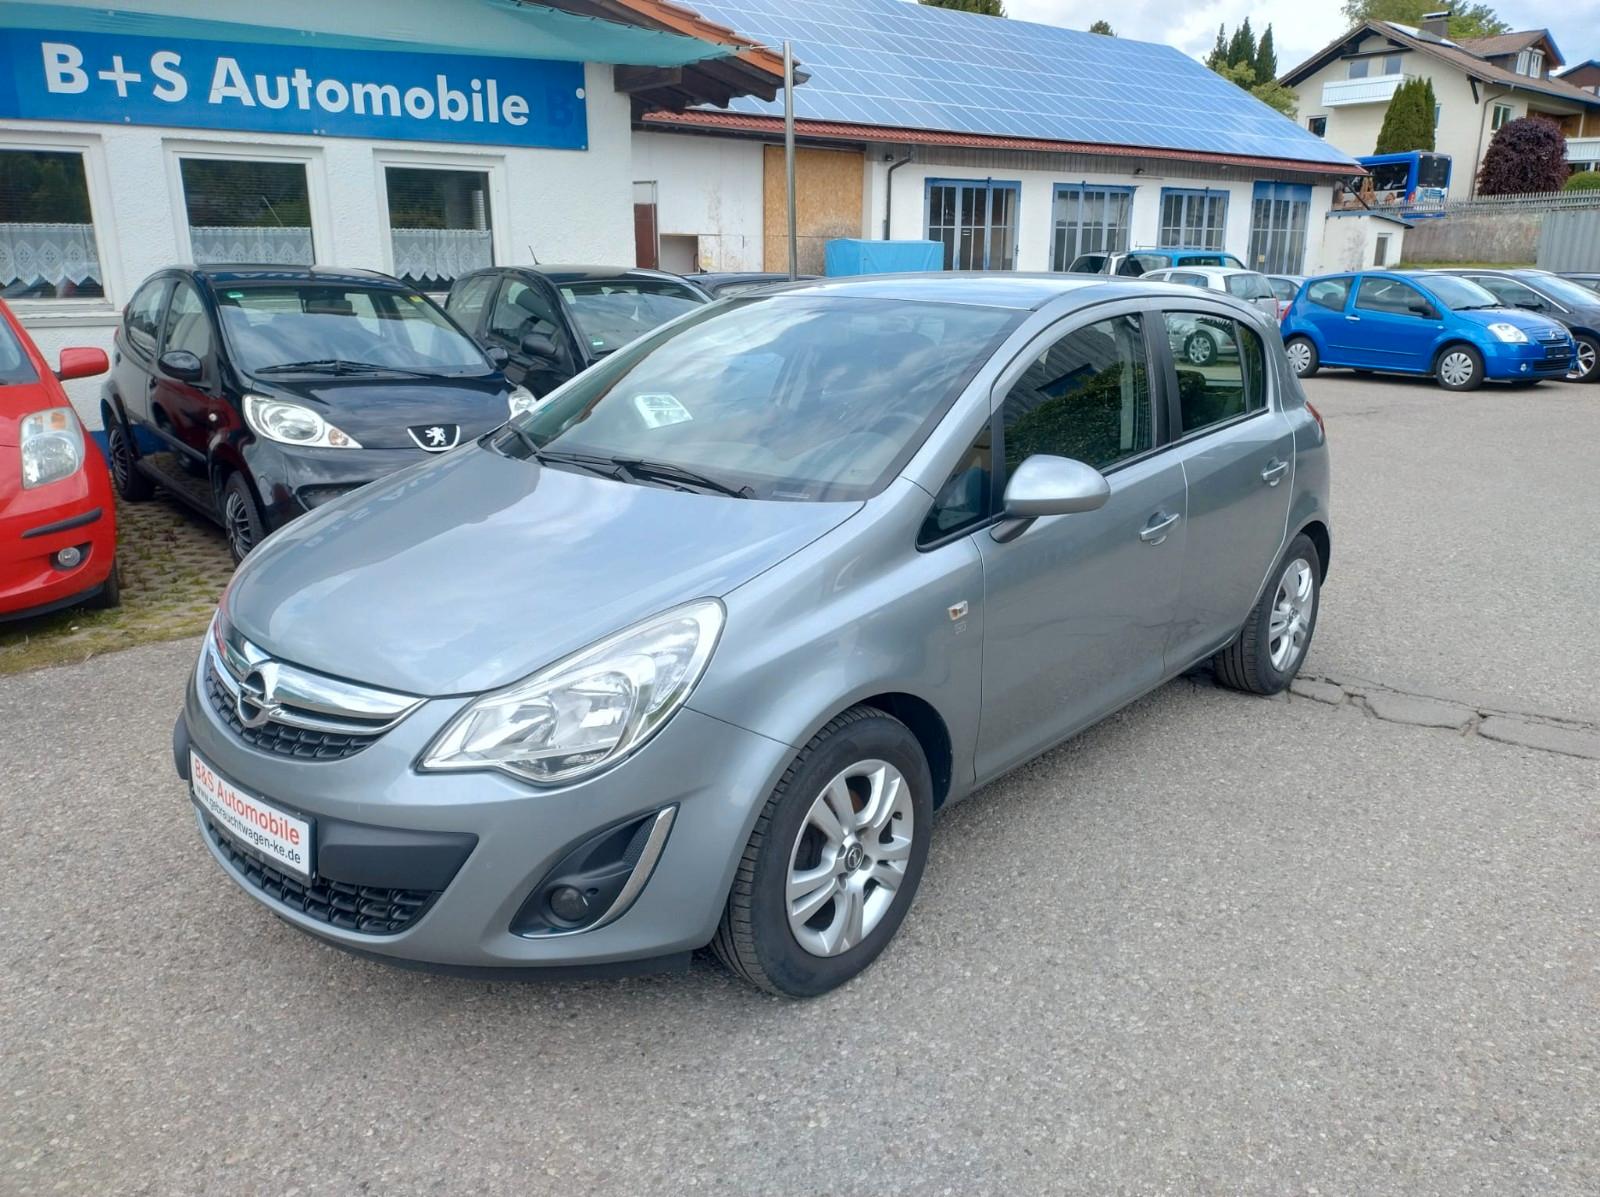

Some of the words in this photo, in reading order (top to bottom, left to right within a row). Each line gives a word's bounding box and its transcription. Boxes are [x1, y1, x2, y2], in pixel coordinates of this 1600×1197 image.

[41, 42, 188, 102] B+S
[208, 57, 530, 126] Automobile
[195, 758, 214, 792] B&S
[217, 780, 299, 845] Automobile
